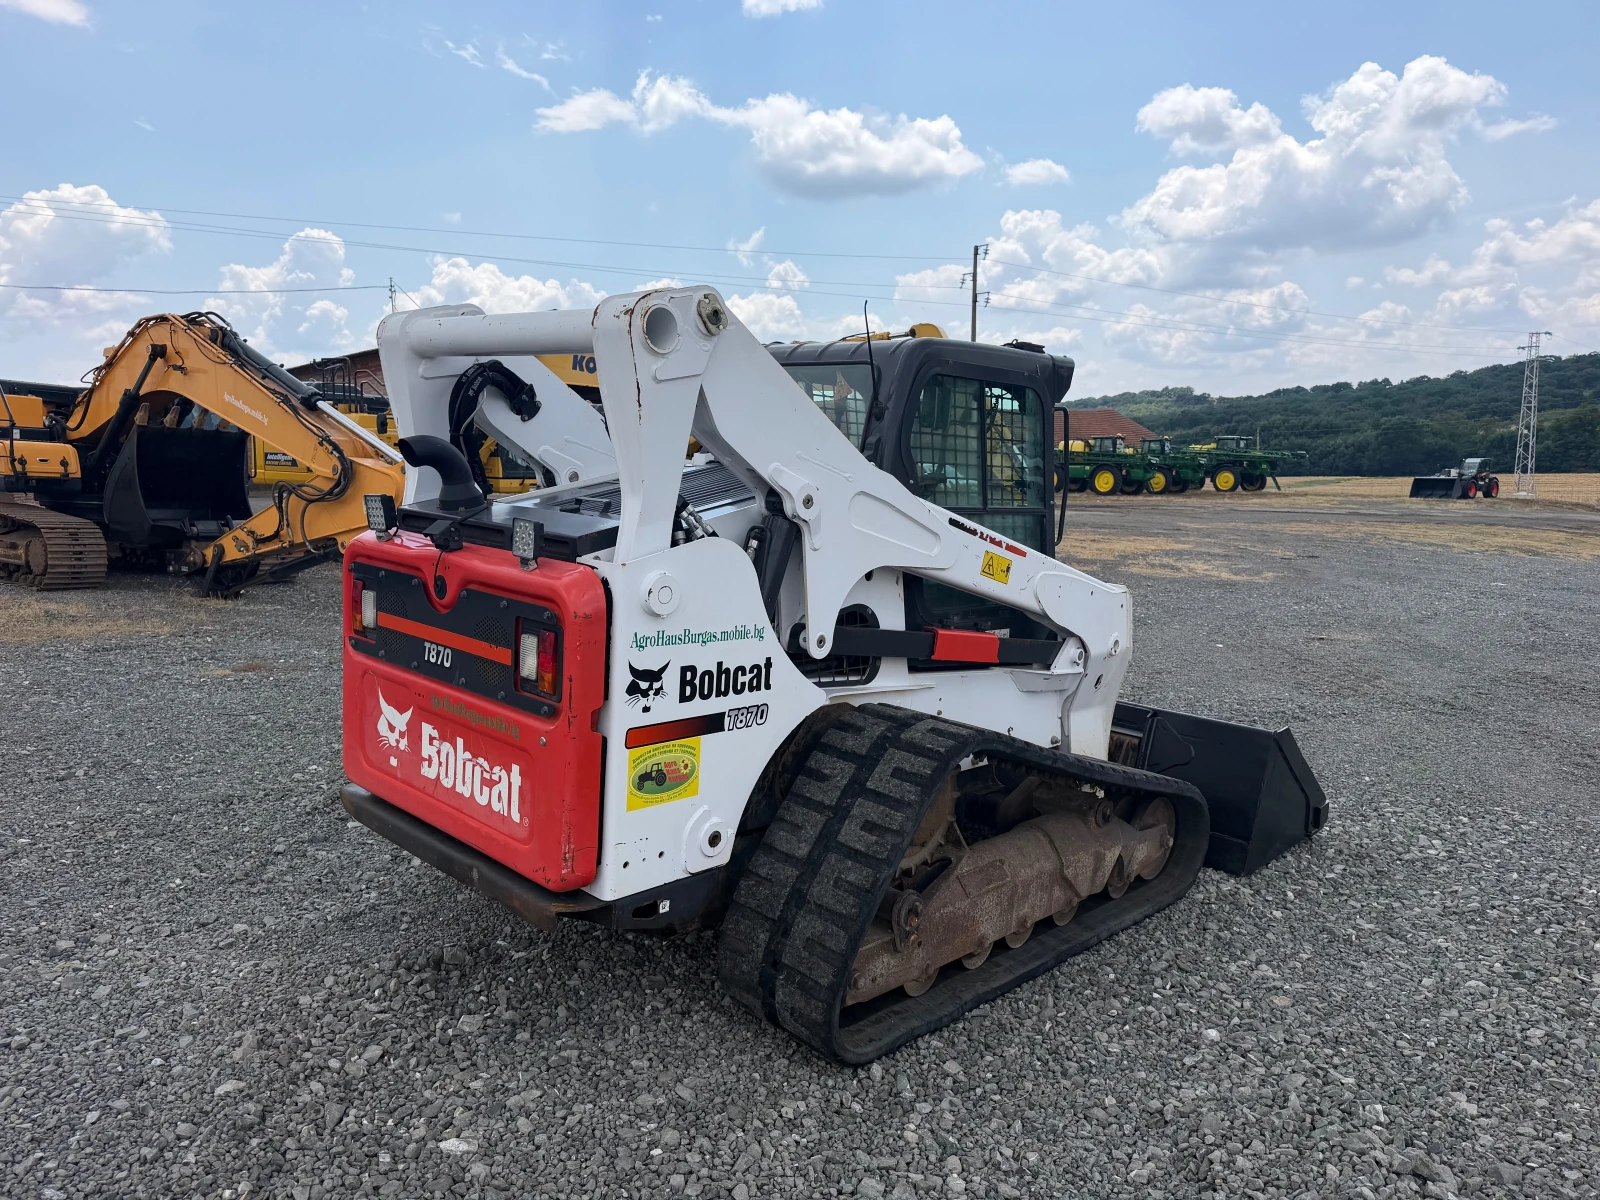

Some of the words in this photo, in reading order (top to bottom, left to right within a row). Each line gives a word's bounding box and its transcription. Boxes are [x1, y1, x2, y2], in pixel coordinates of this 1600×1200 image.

[630, 624, 765, 652] AgroHausBurgas.mobile.bg
[424, 641, 452, 668] T870
[679, 656, 773, 704] Bobcat
[727, 703, 769, 731] T870
[420, 721, 522, 824] Bobcat
